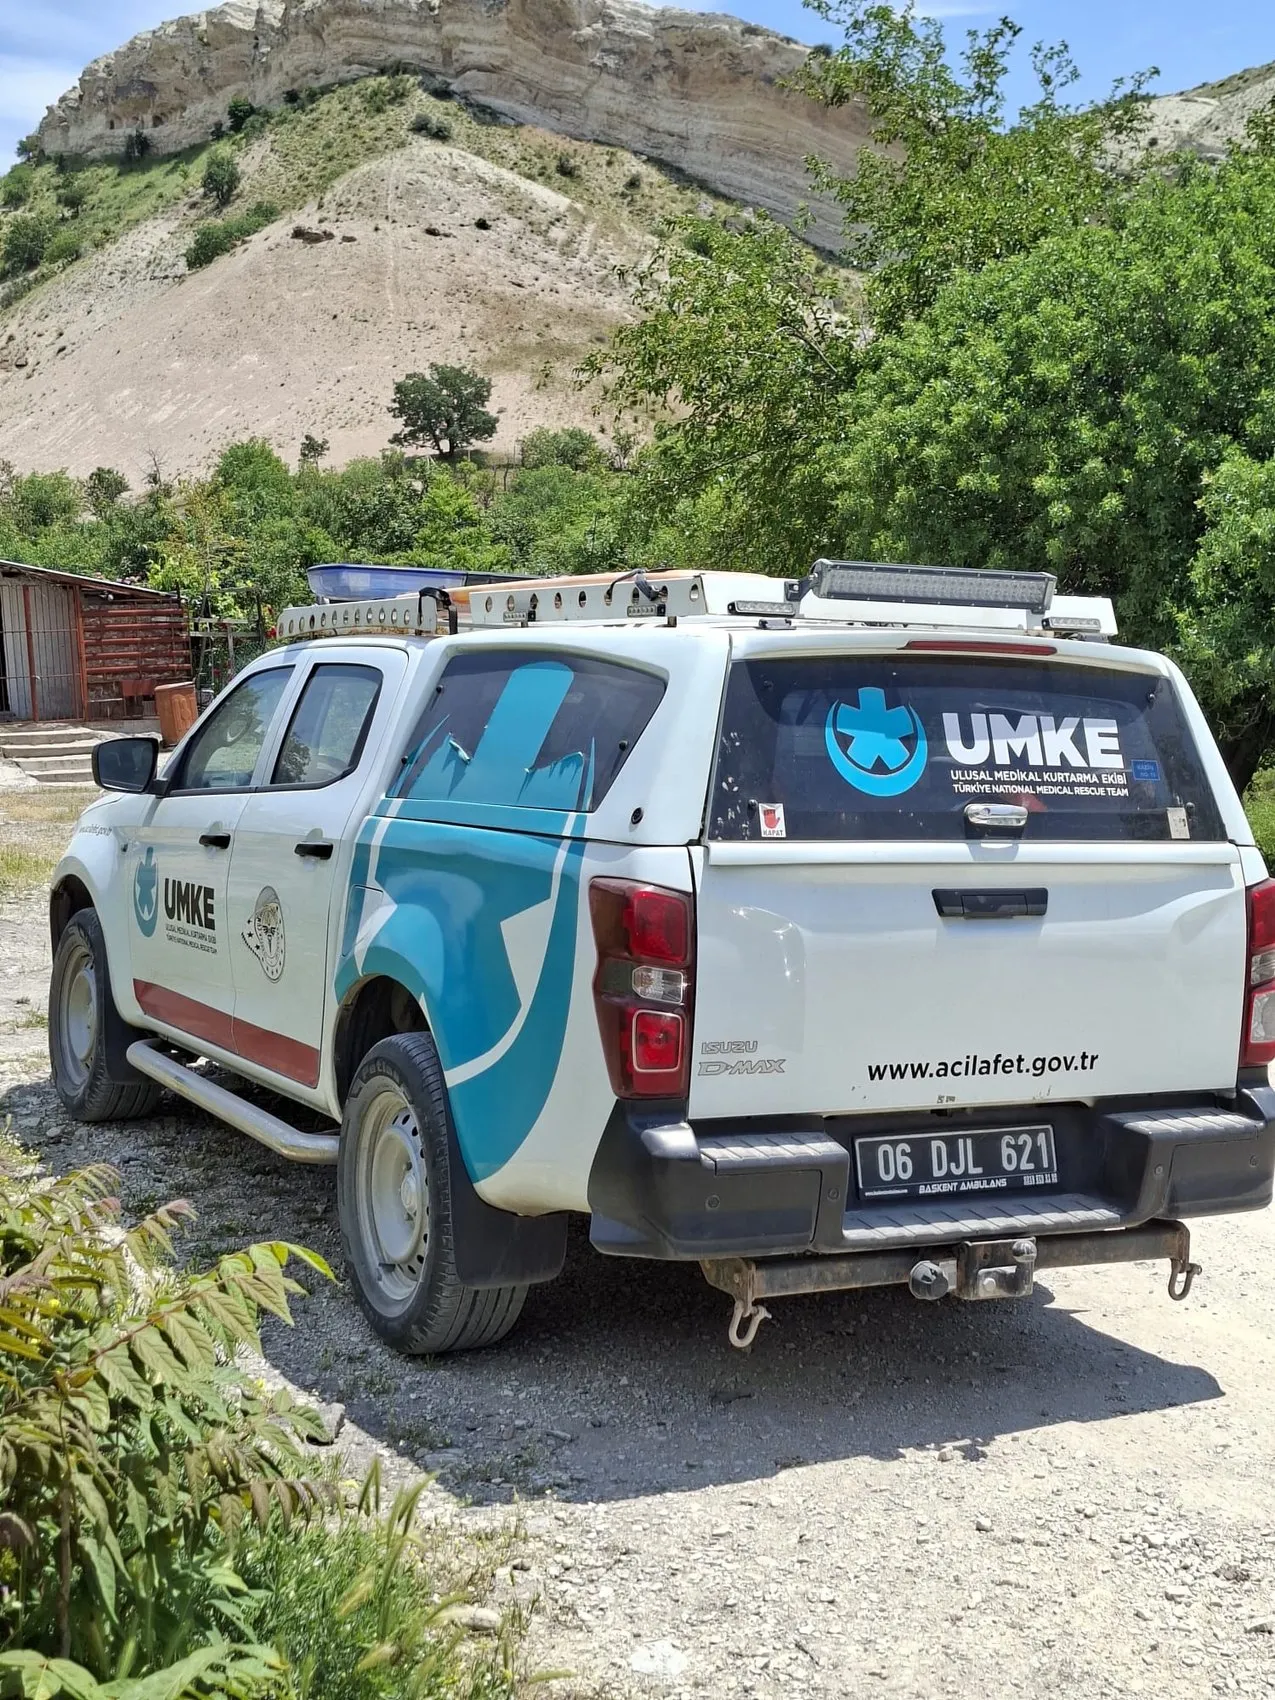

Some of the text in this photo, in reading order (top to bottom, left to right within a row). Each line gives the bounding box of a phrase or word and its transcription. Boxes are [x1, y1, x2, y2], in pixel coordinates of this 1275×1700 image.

[942, 712, 1125, 769] UMKE
[950, 768, 1127, 785] ULUSAL MEDİKAL KURTARMA EKİBİ
[952, 782, 1129, 797] TÜRKİYE NATIONAL MEDICAL RESCUE TEAM
[164, 877, 216, 931] UMKE
[701, 1040, 759, 1055] ISUZU
[867, 1051, 1099, 1081] www.acilafet.gov.tr
[877, 1131, 1050, 1182] 06 DJL 621
[918, 1182, 959, 1195] BASKENT
[959, 1178, 1008, 1191] AMBULANS
